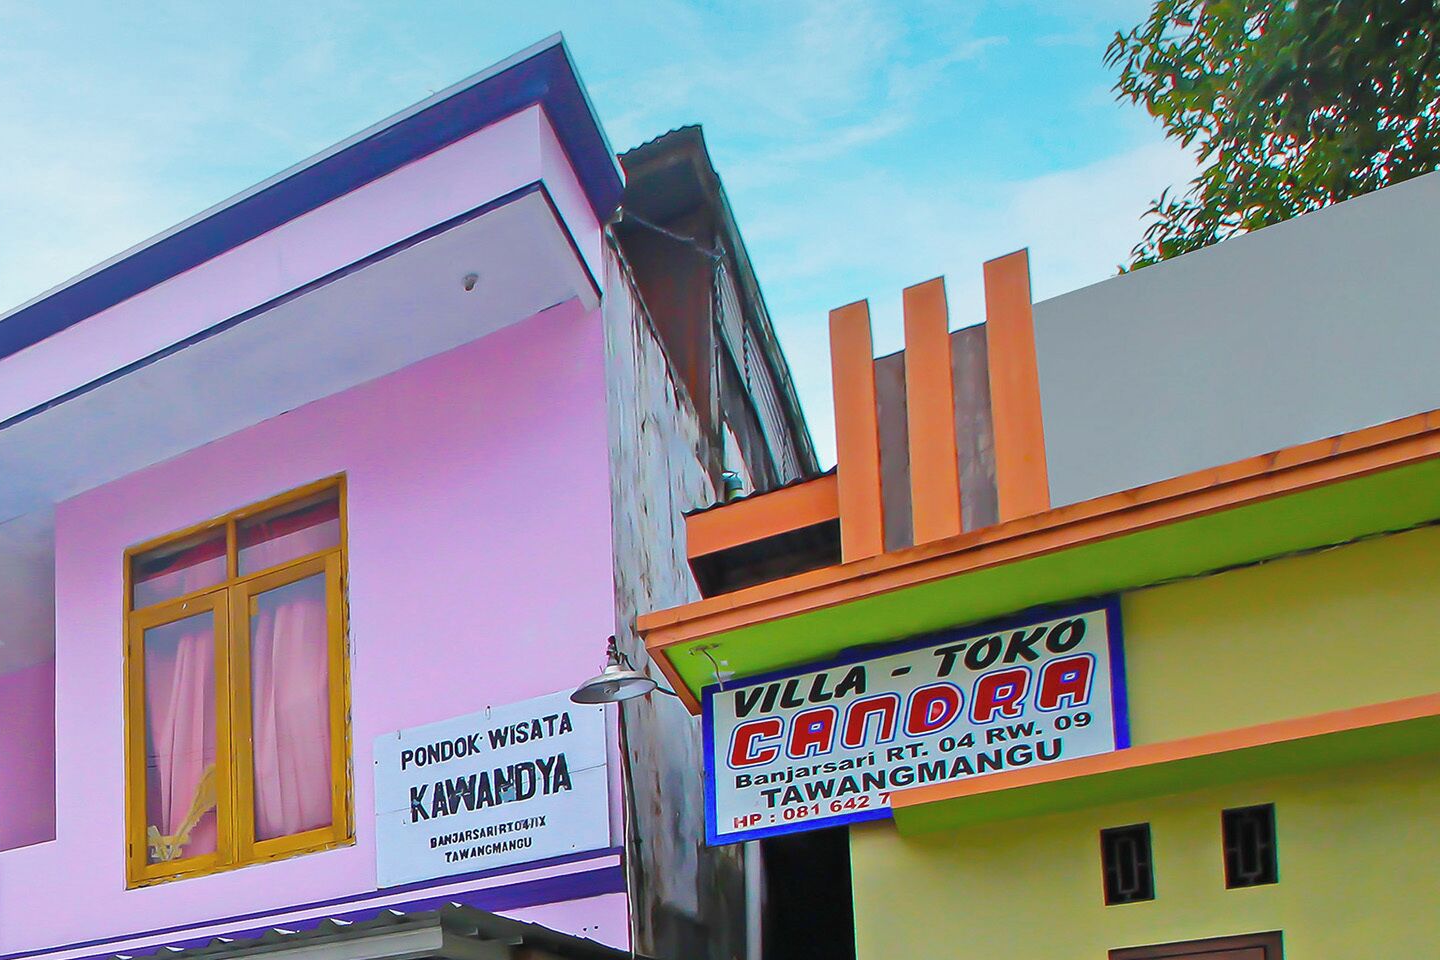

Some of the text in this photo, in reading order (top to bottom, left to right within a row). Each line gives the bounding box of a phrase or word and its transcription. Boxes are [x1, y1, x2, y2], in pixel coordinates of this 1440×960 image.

[734, 665, 867, 718] VILLA
[934, 617, 1087, 678] TOKO
[401, 712, 573, 770] PONDOK WISATA
[727, 652, 1097, 770] CANDRA
[735, 711, 1092, 789] Banjarsari RT. 04 RW. 09
[761, 738, 1062, 809] TAWANGMANGU
[410, 752, 572, 823] KAWANDYA
[783, 803, 820, 820] 081
[830, 796, 869, 813] 642
[430, 826, 498, 849] BANJARSARI
[445, 837, 532, 863] TAWANGMANGU
